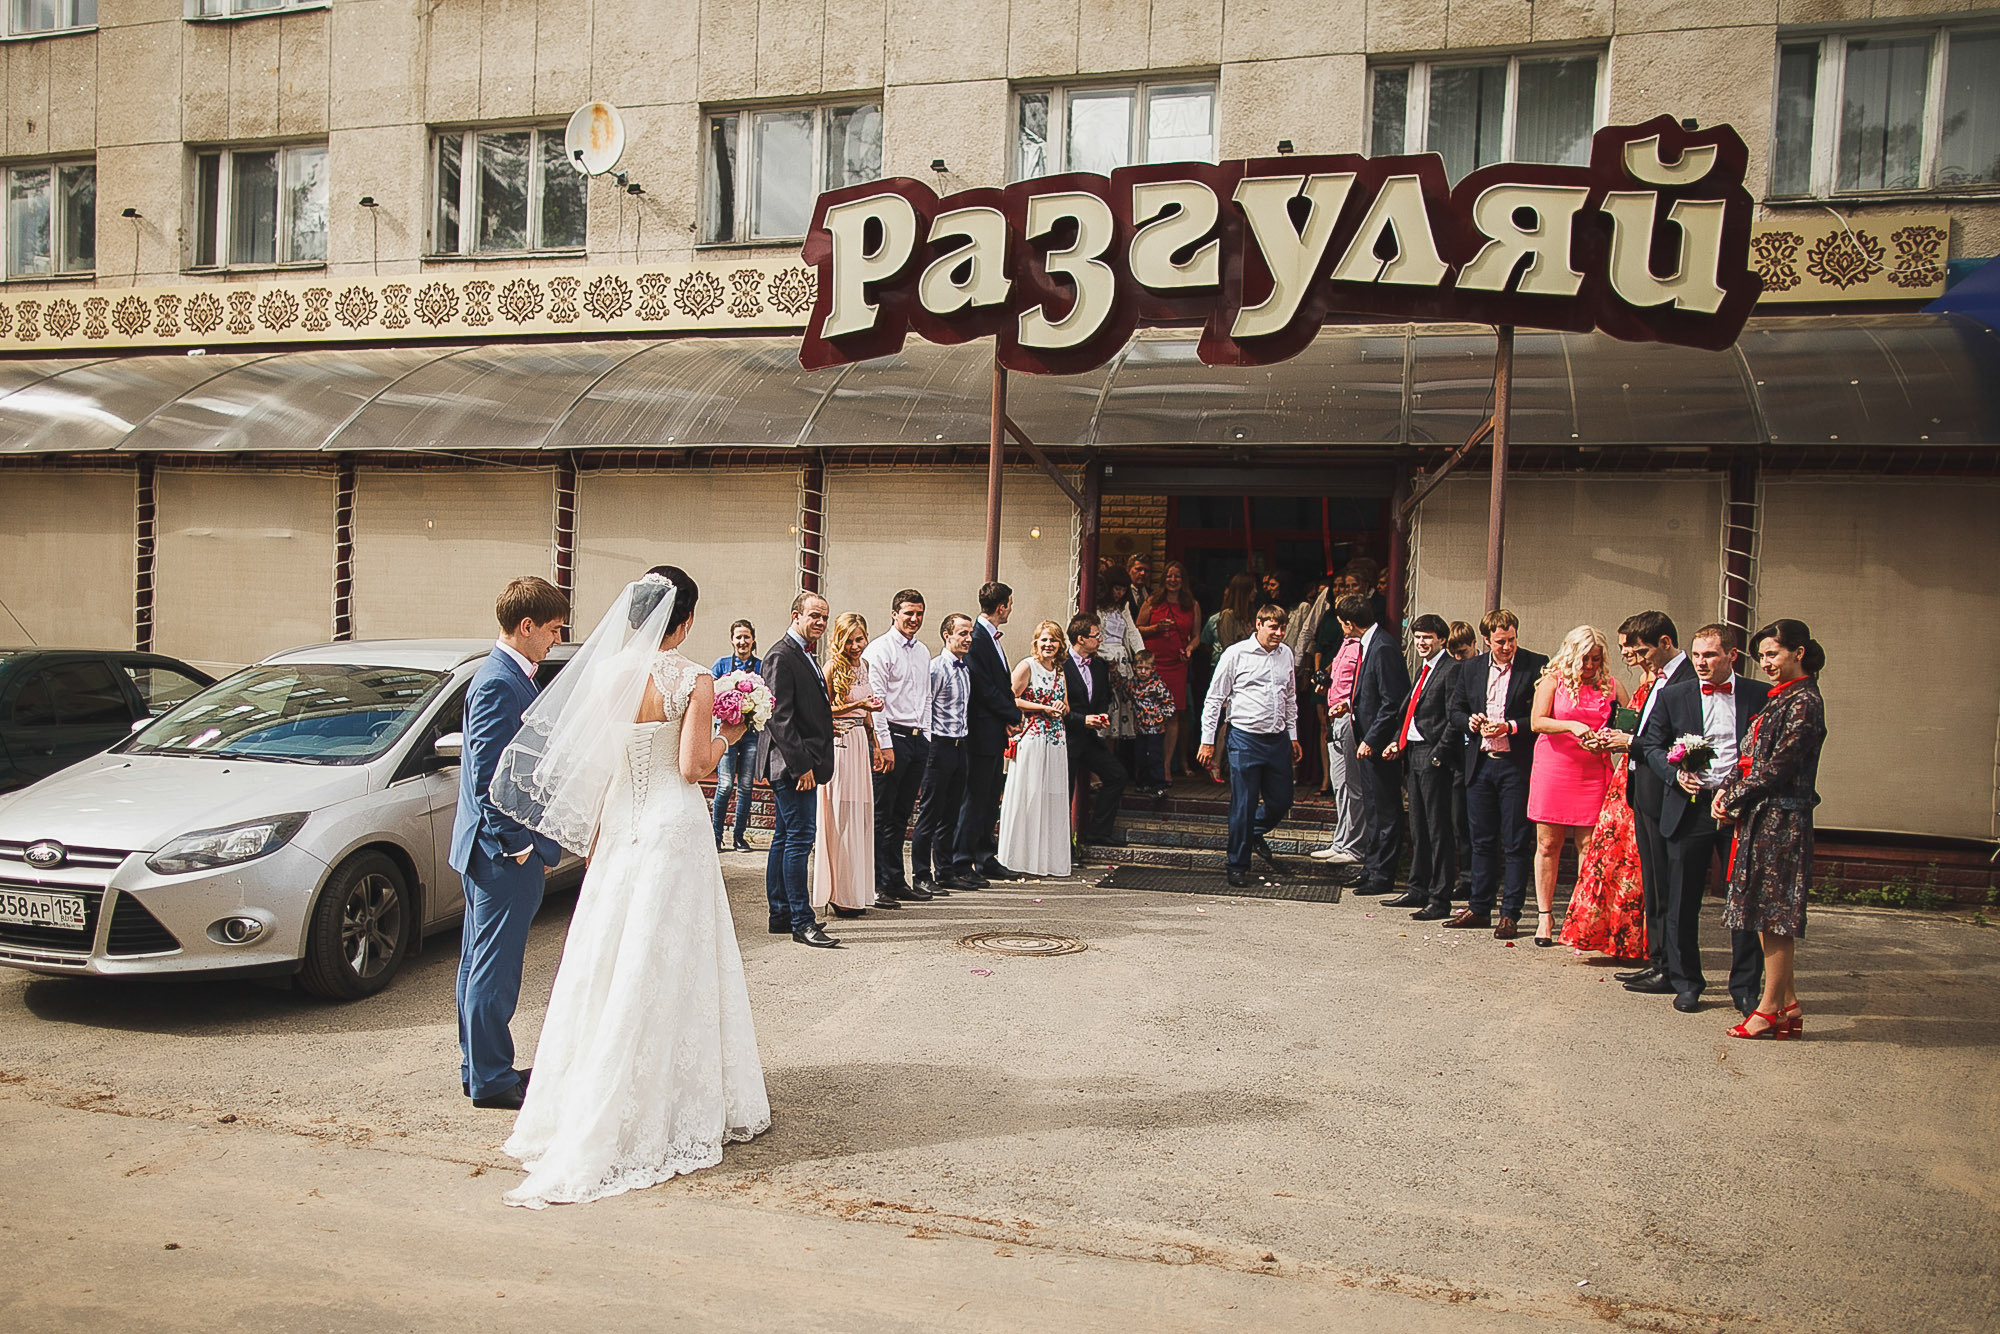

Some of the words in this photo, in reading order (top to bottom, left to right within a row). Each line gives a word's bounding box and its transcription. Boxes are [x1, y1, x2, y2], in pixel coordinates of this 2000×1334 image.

[820, 134, 1728, 348] Разгуляй
[30, 851, 53, 861] Ford
[54, 898, 81, 917] 152
[60, 914, 74, 922] RUS
